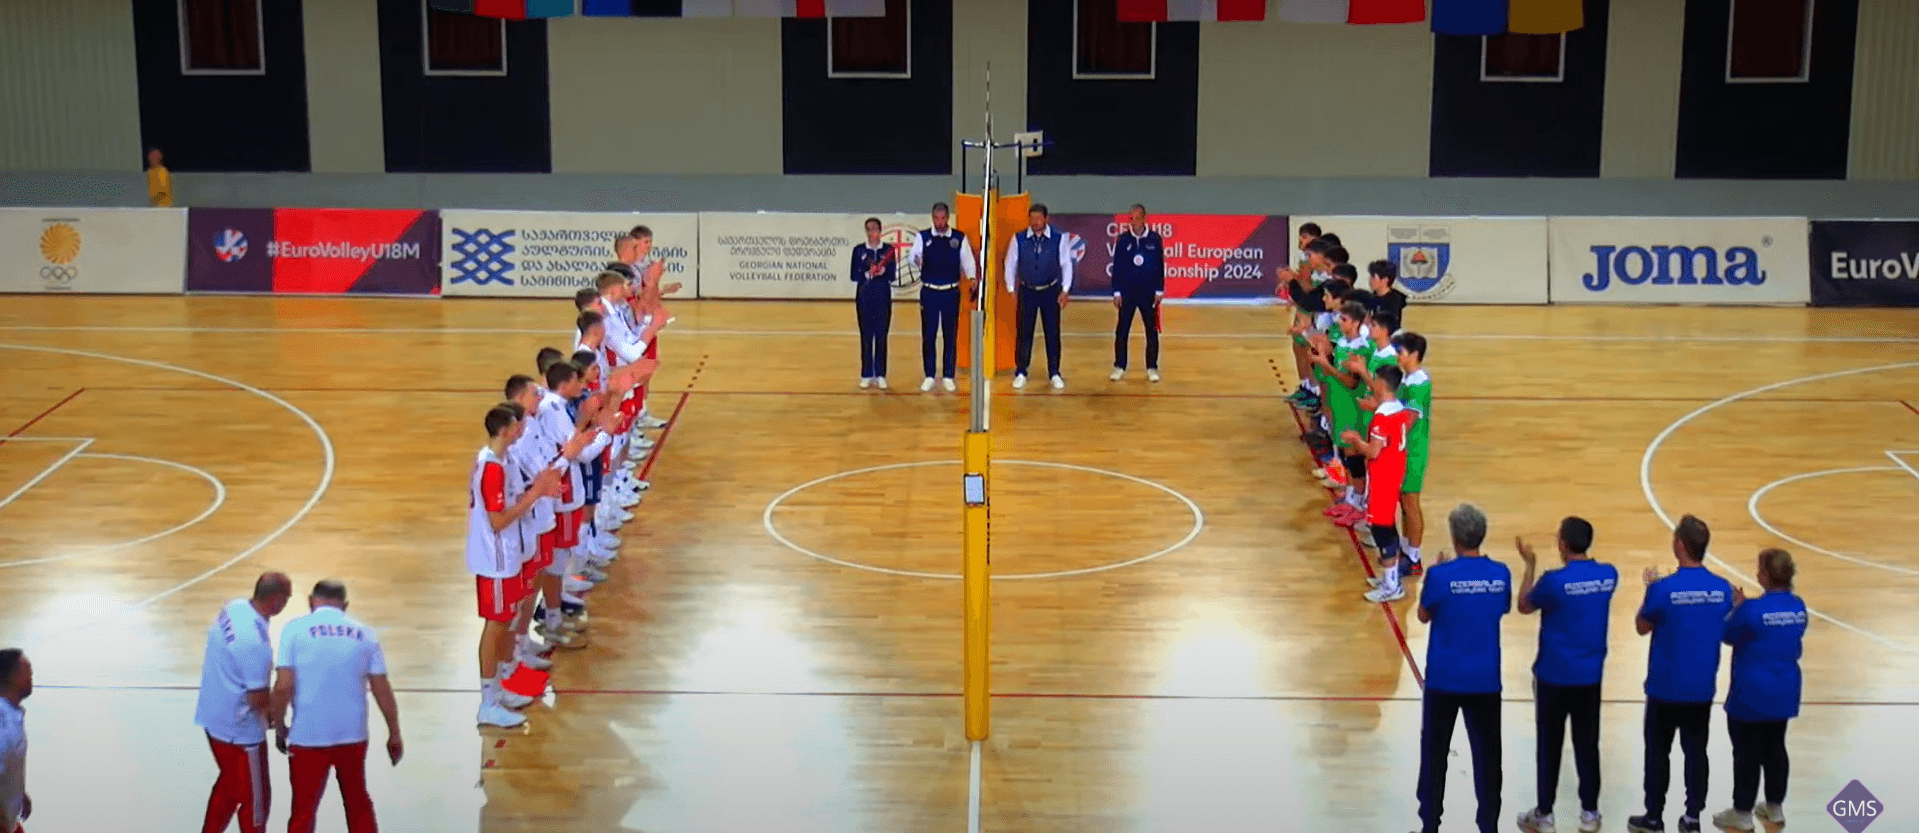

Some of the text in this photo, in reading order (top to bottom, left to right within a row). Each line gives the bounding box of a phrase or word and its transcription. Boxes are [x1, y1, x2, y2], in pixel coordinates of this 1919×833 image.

[266, 241, 421, 262] #EuroVolleyU18M
[1188, 244, 1264, 262] European
[521, 259, 544, 272] და
[739, 260, 828, 271] GEORGIAN NATIONAL
[1223, 264, 1263, 279] 2024
[729, 271, 837, 282] VOLLEYBALL FEDERATION
